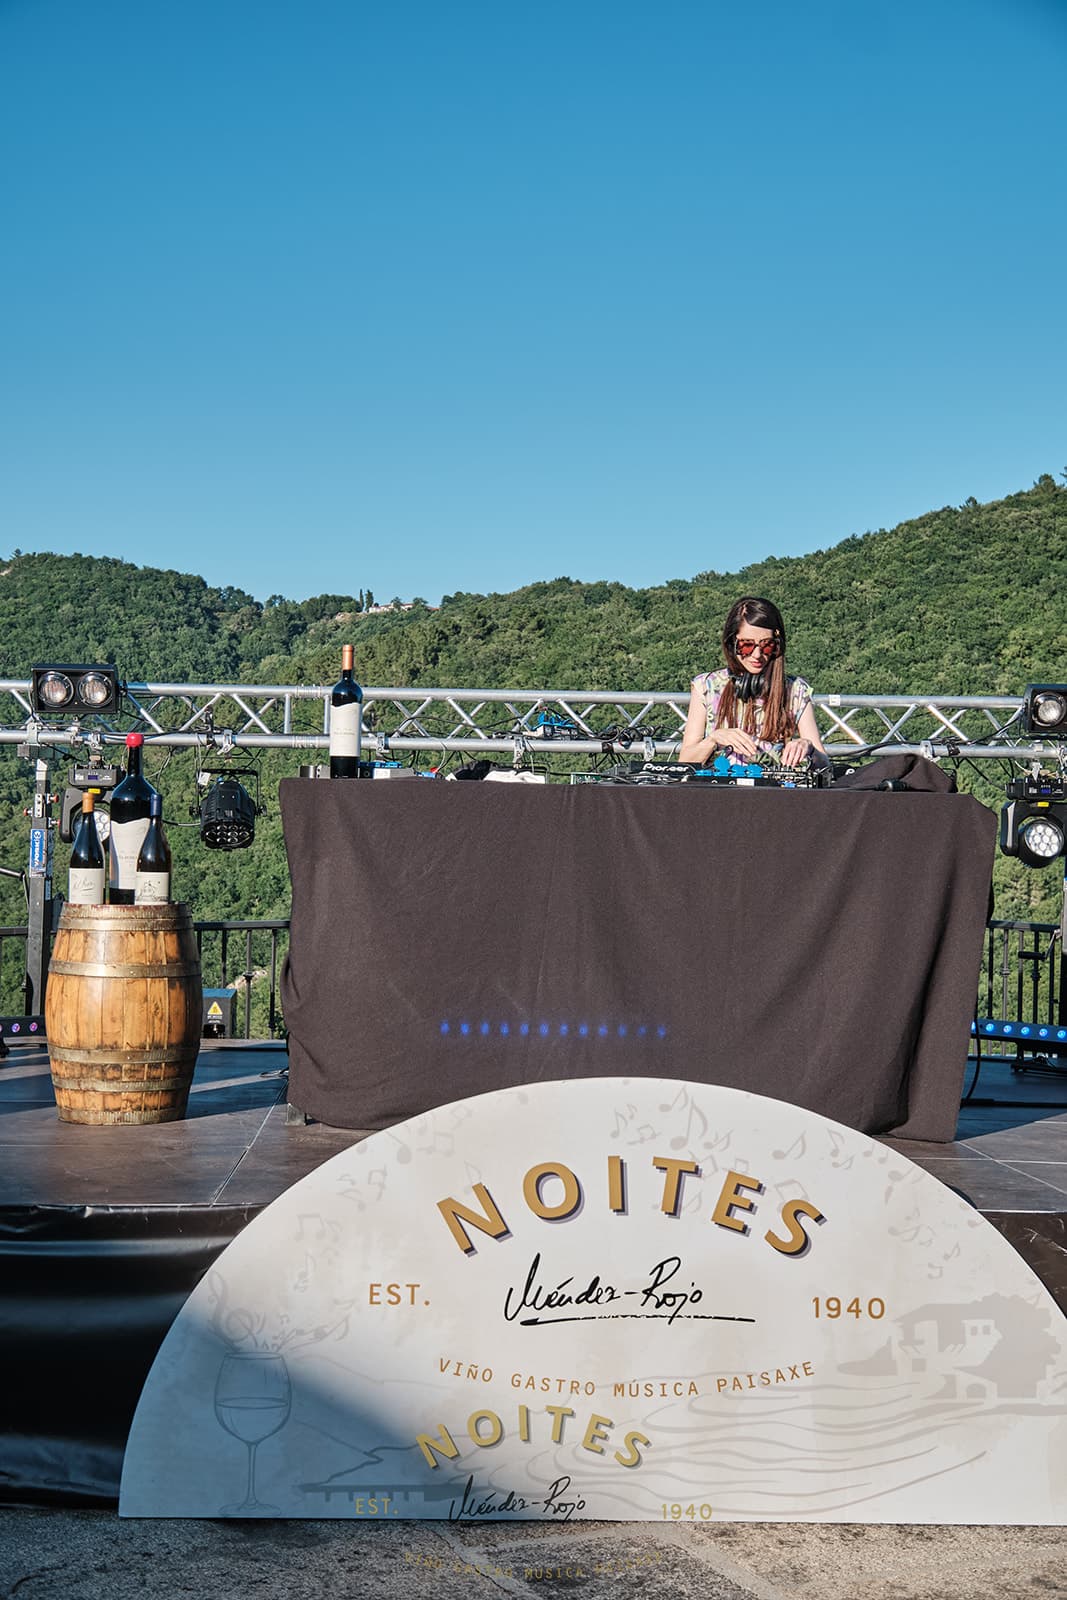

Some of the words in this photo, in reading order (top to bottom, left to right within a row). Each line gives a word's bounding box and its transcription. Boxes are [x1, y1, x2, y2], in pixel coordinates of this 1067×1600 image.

[437, 1155, 827, 1259] NOITES
[368, 1283, 431, 1306] EST.
[505, 1253, 703, 1325] Méndez-Rojo
[812, 1297, 885, 1319] 1940
[439, 1358, 493, 1383] VIÑO
[511, 1374, 596, 1396] GASTRO
[613, 1379, 698, 1398] MÚSICA
[716, 1361, 814, 1393] PAISAXE
